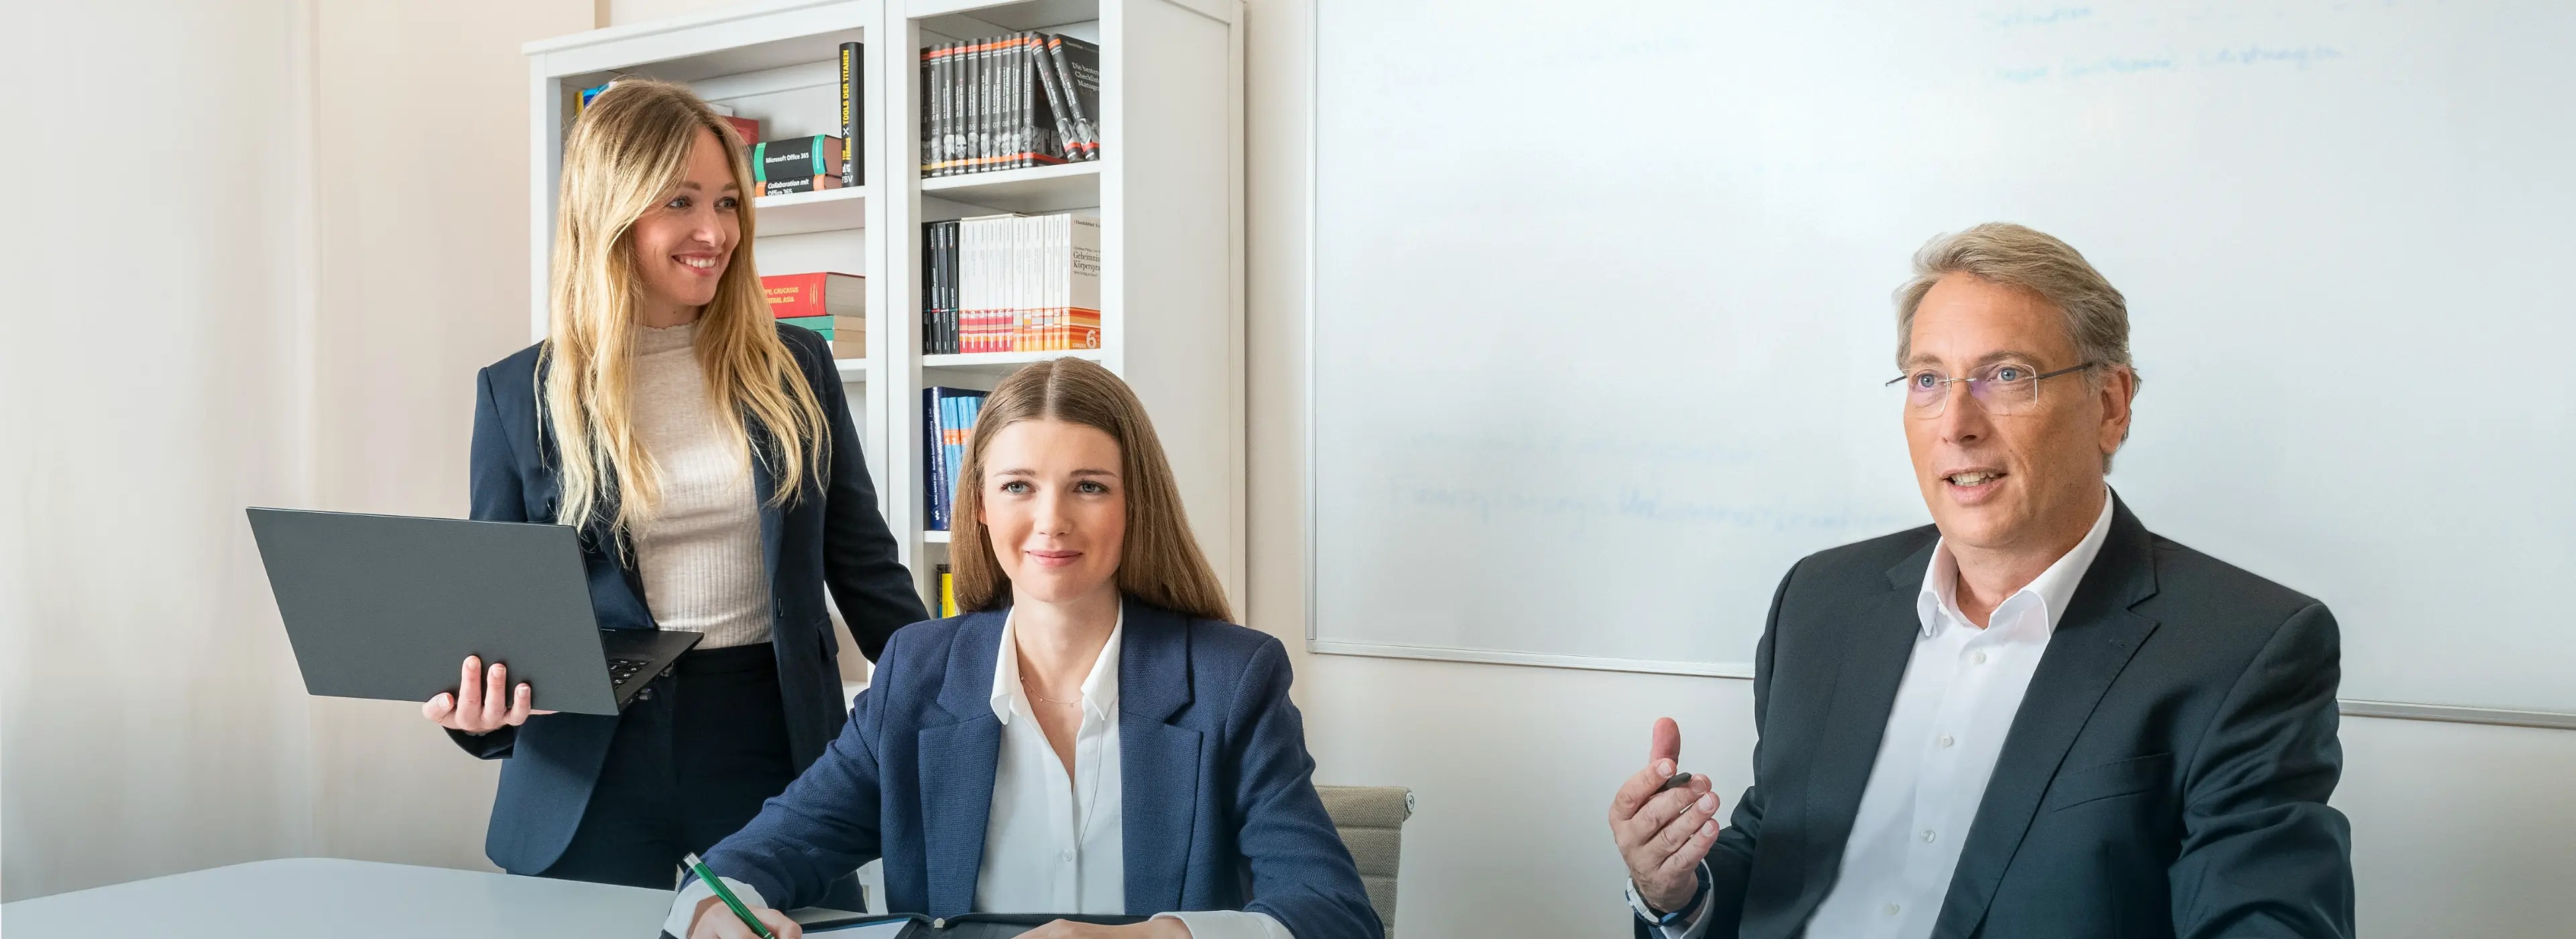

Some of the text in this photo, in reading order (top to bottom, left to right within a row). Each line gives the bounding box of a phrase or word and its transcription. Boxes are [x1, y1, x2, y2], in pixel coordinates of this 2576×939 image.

[1072, 62, 1082, 70] Die
[766, 155, 786, 163] Microsoft
[768, 180, 800, 189] Collaboration
[1087, 330, 1096, 349] 6
